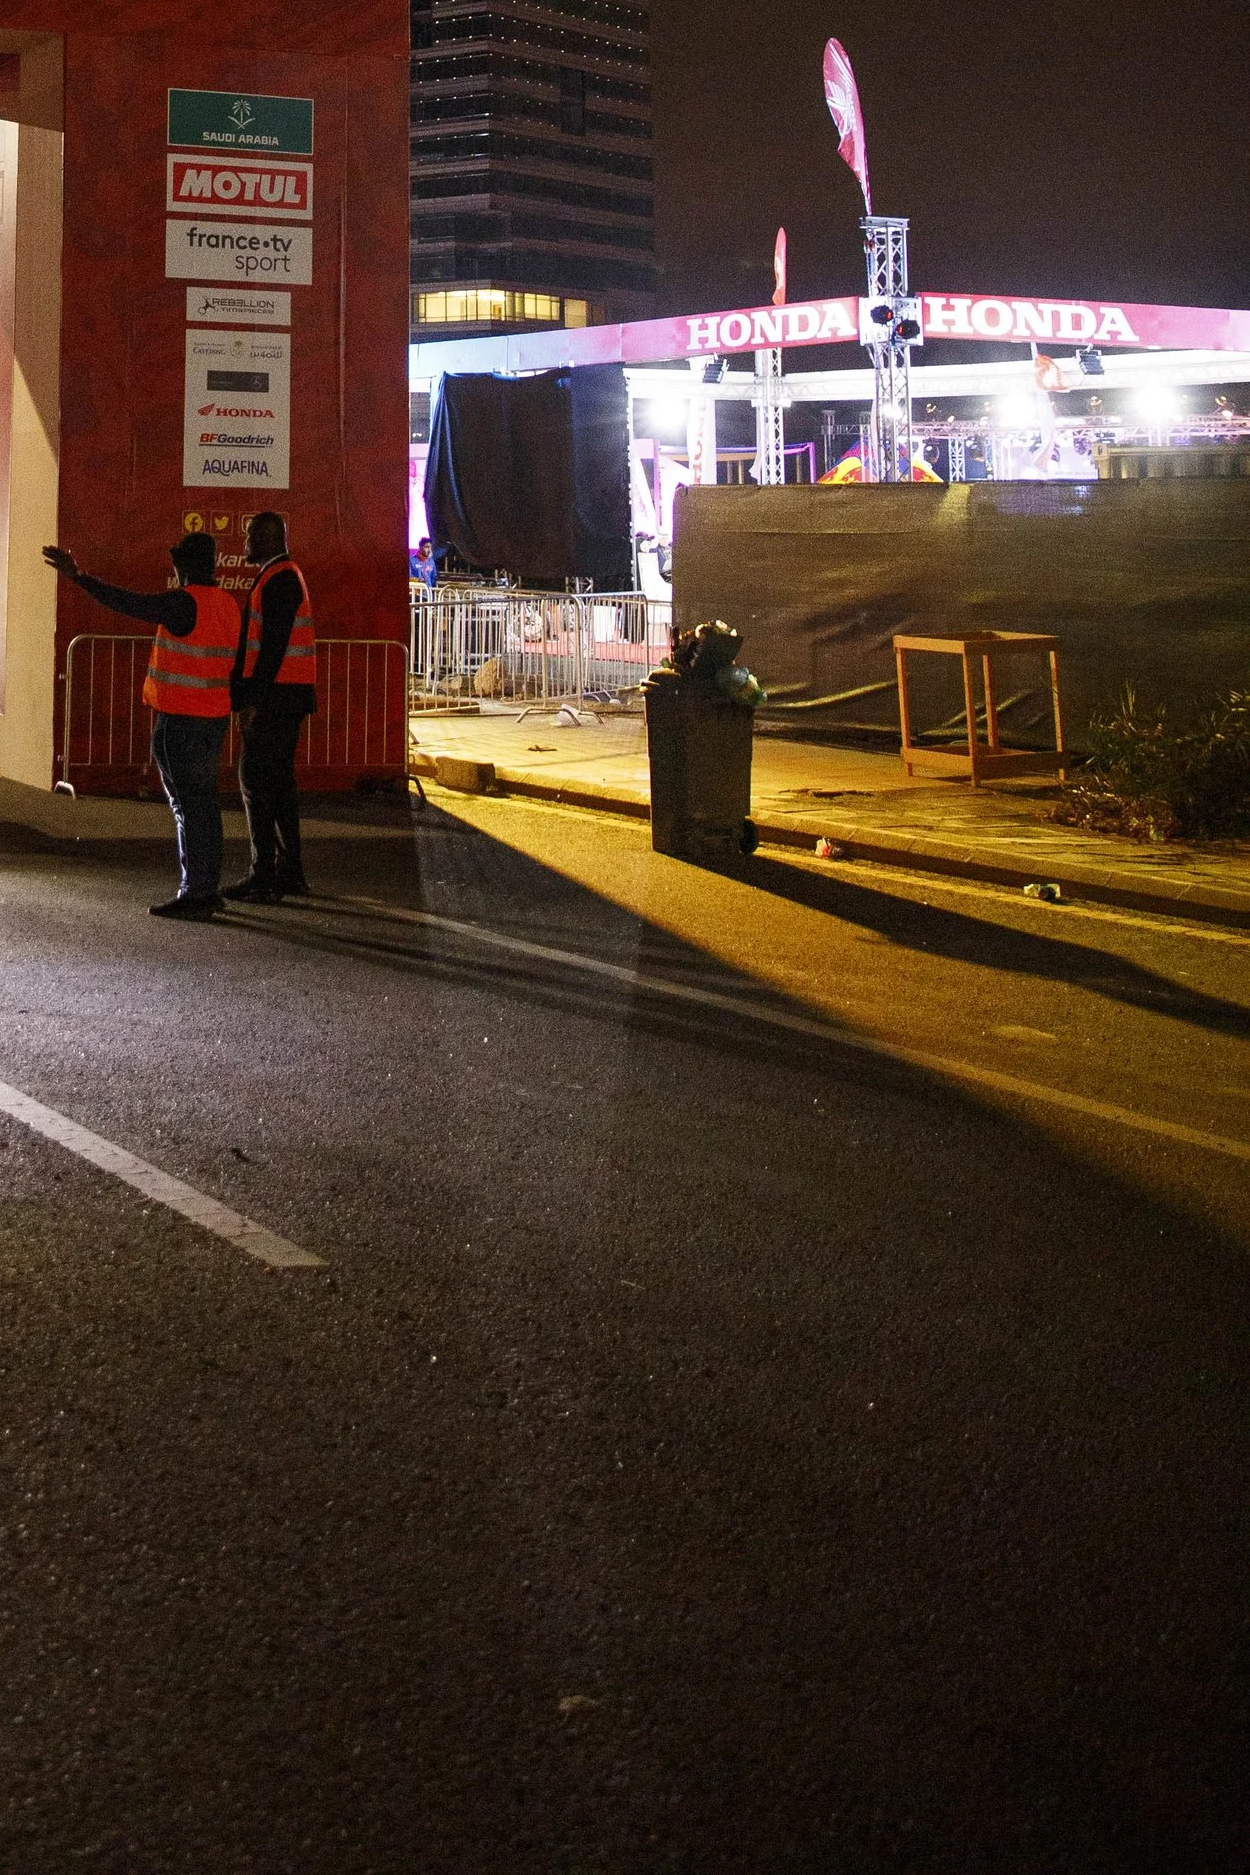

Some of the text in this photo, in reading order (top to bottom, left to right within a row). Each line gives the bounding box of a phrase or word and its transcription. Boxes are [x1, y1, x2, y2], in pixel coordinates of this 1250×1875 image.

[202, 131, 280, 146] SAUDI ARABIA
[179, 169, 302, 203] MOTUL
[235, 255, 291, 276] sport
[686, 301, 858, 350] HONDA
[924, 297, 1139, 342] HONDA
[216, 408, 275, 418] HONDA
[200, 433, 275, 445] BFGoodrich
[202, 459, 269, 477] AQUAFINA
